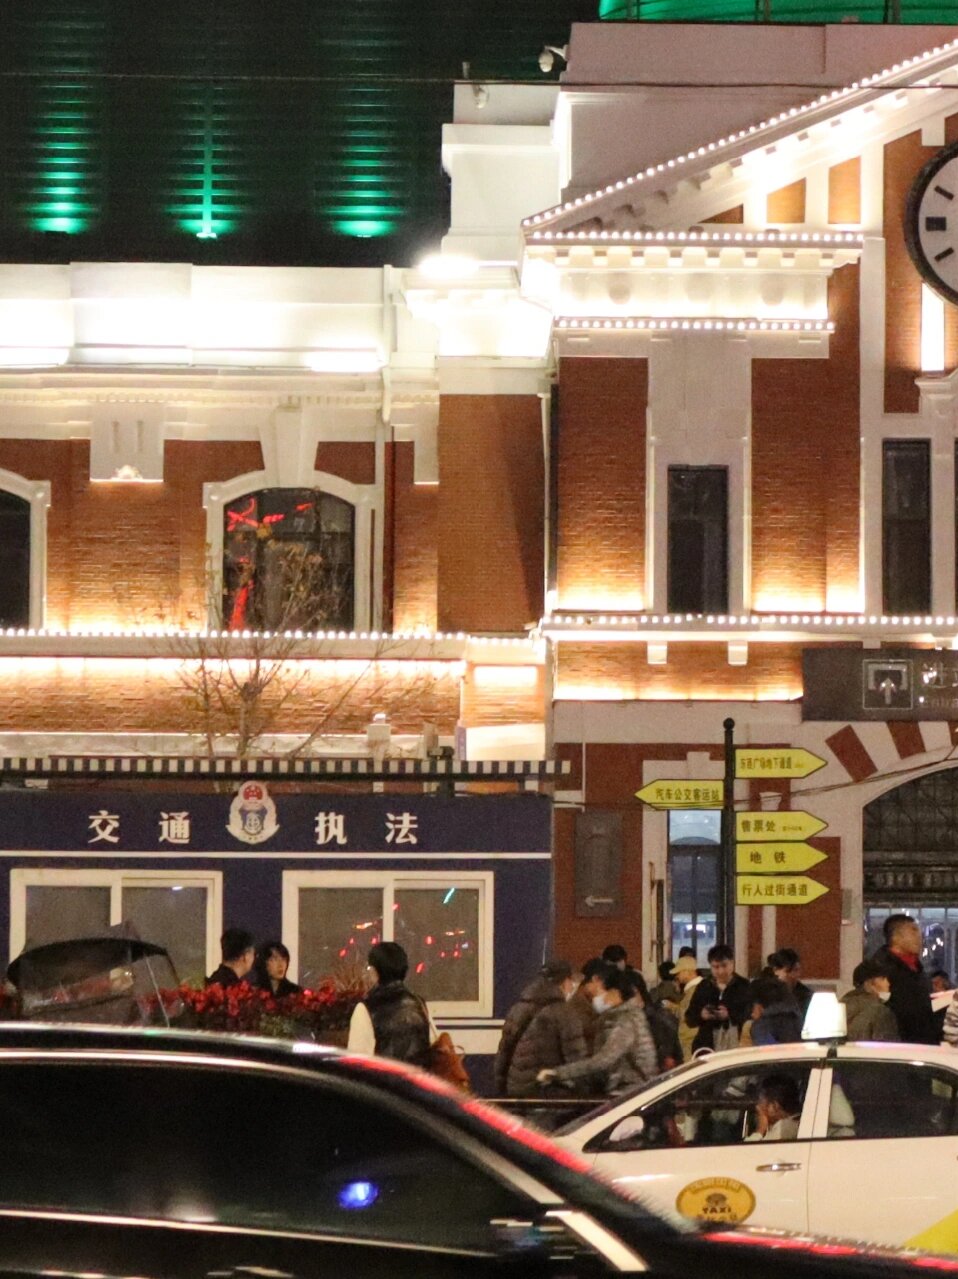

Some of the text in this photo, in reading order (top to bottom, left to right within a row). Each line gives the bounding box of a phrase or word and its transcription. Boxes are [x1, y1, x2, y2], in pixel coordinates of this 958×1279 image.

[87, 809, 419, 846] 交通 执法
[741, 819, 776, 833] 售票处
[749, 850, 787, 864] 地铁
[742, 883, 808, 897] 行人过街通道
